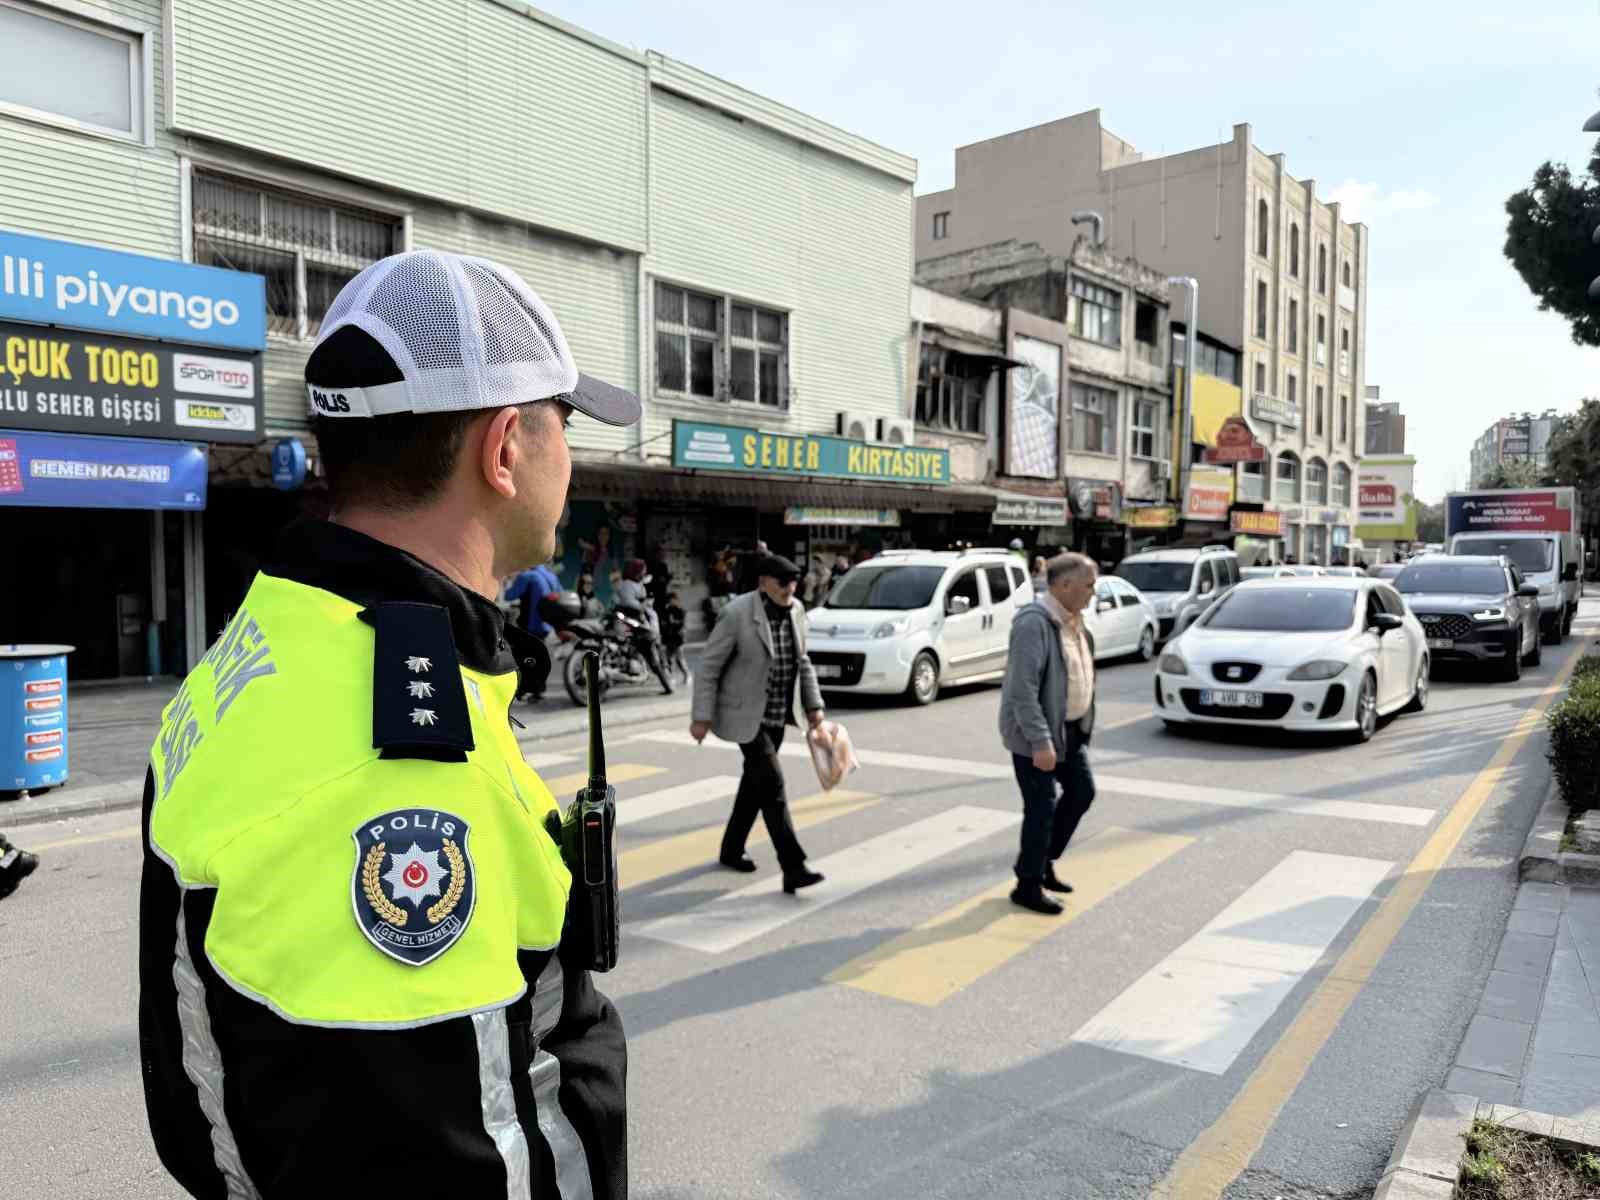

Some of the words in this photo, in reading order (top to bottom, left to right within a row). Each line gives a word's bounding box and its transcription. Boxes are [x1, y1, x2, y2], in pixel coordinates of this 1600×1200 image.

[56, 270, 240, 329] piyango
[84, 345, 160, 388] TOGO
[0, 388, 28, 412] LU
[36, 391, 95, 417] SEHER
[101, 393, 161, 425] GİŞESİ
[33, 462, 98, 479] HEMEN
[744, 434, 819, 471] SEHER
[369, 812, 456, 841] POLİS
[381, 926, 415, 945] GENEL
[418, 920, 453, 944] HİZMET
